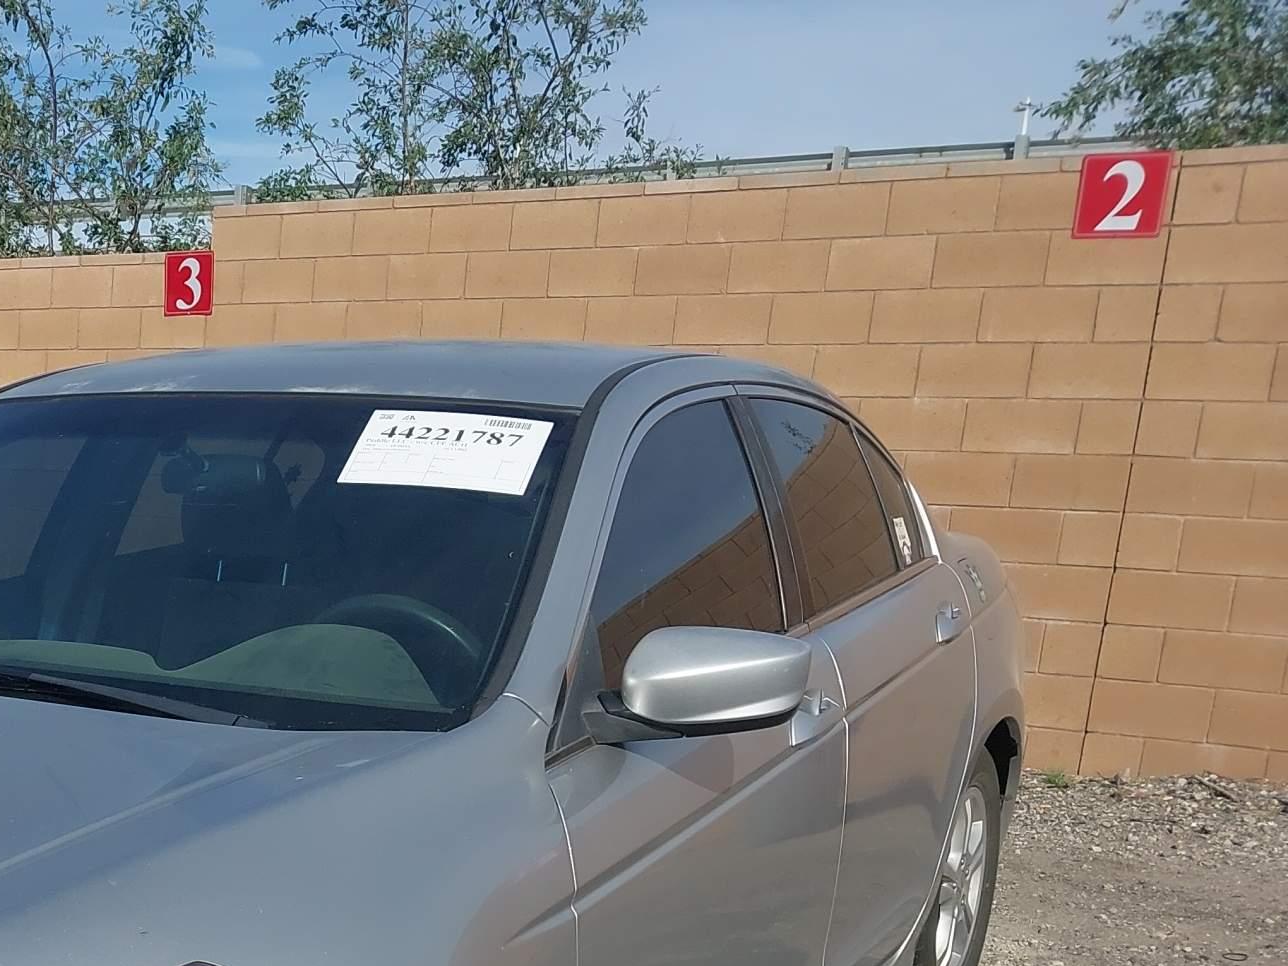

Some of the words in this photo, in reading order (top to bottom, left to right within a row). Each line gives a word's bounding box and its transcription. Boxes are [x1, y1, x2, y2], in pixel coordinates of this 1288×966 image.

[1093, 159, 1146, 232] 2
[175, 256, 202, 311] 3
[379, 424, 525, 448] 44221787
